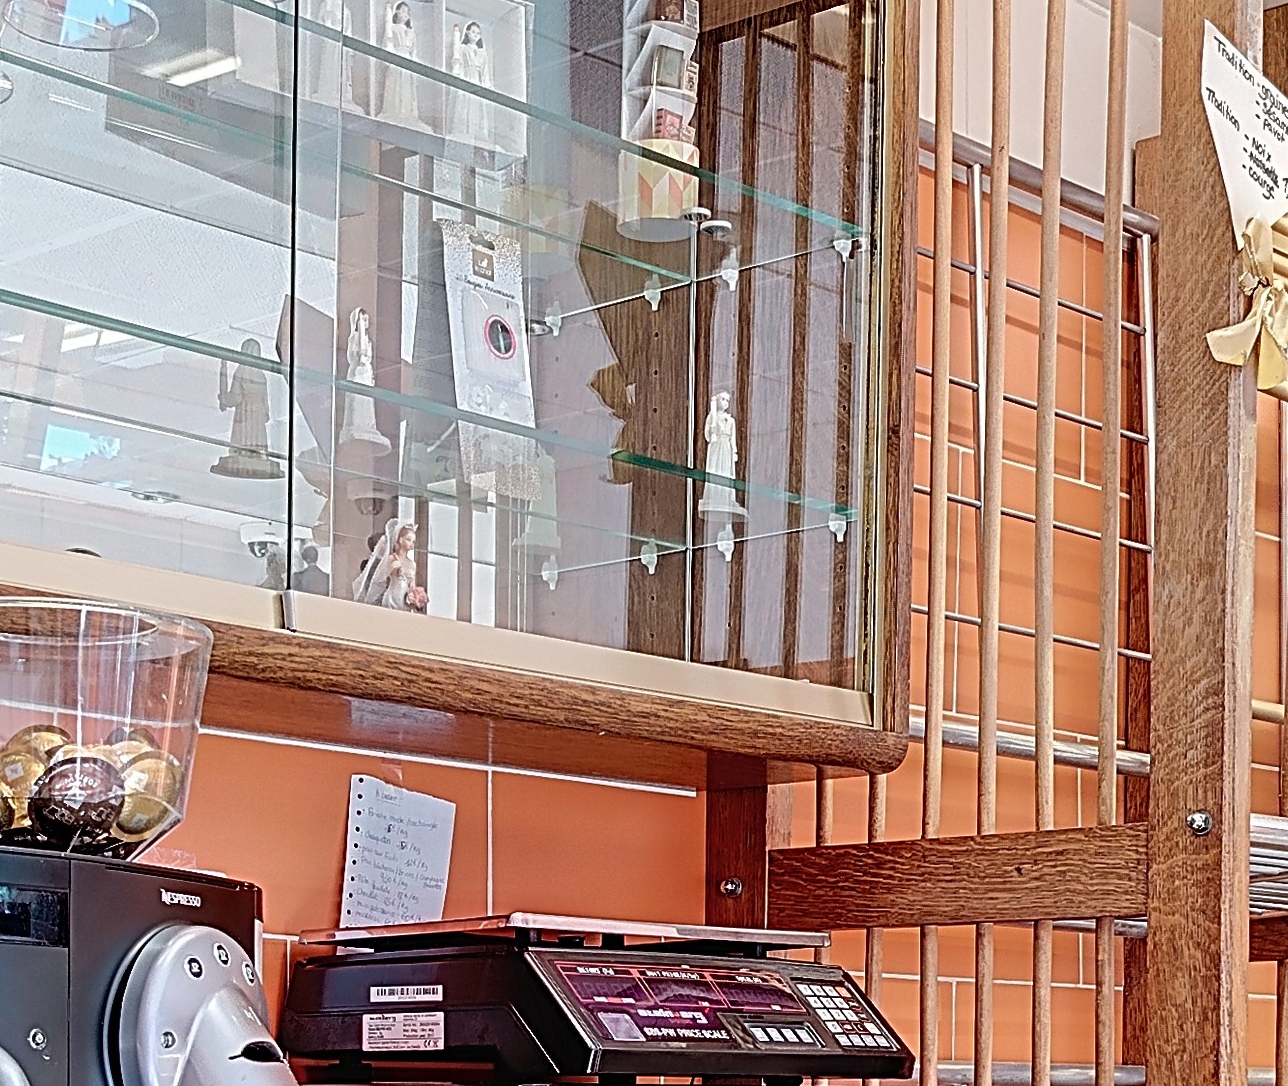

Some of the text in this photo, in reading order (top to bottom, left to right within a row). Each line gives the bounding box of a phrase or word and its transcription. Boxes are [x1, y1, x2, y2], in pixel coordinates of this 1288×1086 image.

[1214, 36, 1255, 87] Tradition
[1205, 86, 1240, 132] Tradition
[160, 888, 201, 908] NESPRESSO
[676, 1028, 701, 1038] PRICE
[701, 1029, 730, 1040] SCALE
